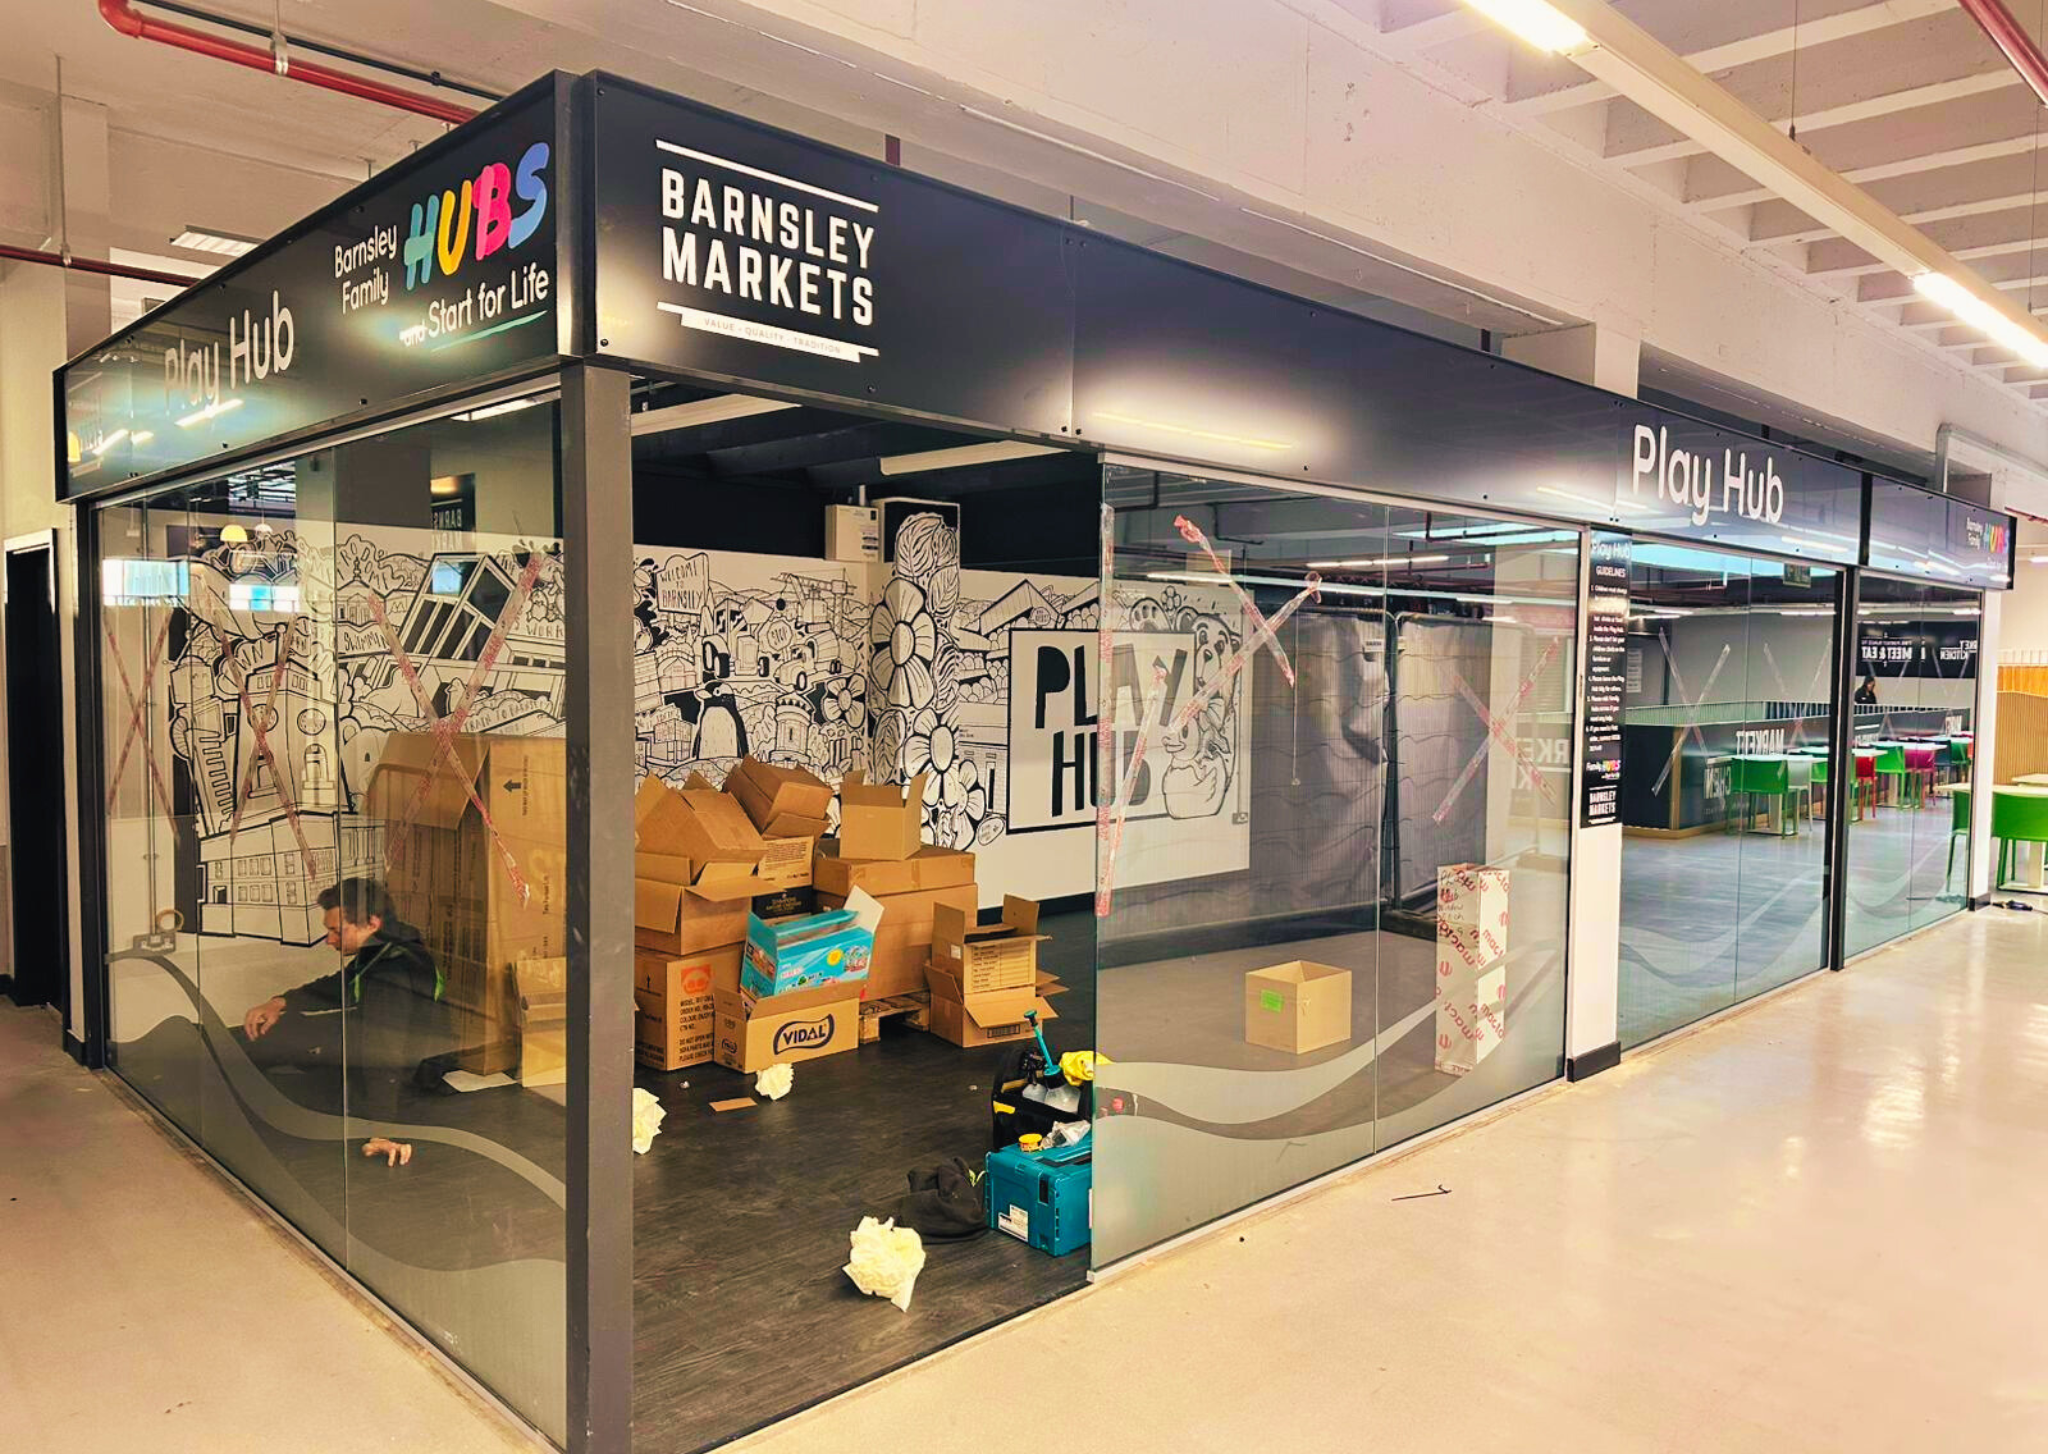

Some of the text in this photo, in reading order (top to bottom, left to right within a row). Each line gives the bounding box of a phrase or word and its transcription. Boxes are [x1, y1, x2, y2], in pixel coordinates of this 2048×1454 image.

[335, 225, 397, 278] Barnsley
[404, 142, 549, 290] HUBS
[662, 168, 874, 269] BARNSLEY
[342, 267, 389, 315] Family
[428, 289, 472, 338] Start
[478, 282, 506, 321] for
[511, 262, 549, 310] Life
[662, 226, 873, 327] MARKETS
[165, 290, 294, 418] Play Hub
[704, 318, 841, 354] VALUE QUALITY TRADITION
[1633, 424, 1783, 526] Play Hub
[1596, 565, 1626, 578] GUIDELINES
[1035, 644, 1189, 729] PLAY
[1052, 730, 1152, 818] HUB
[783, 1025, 826, 1045] VIDAL
